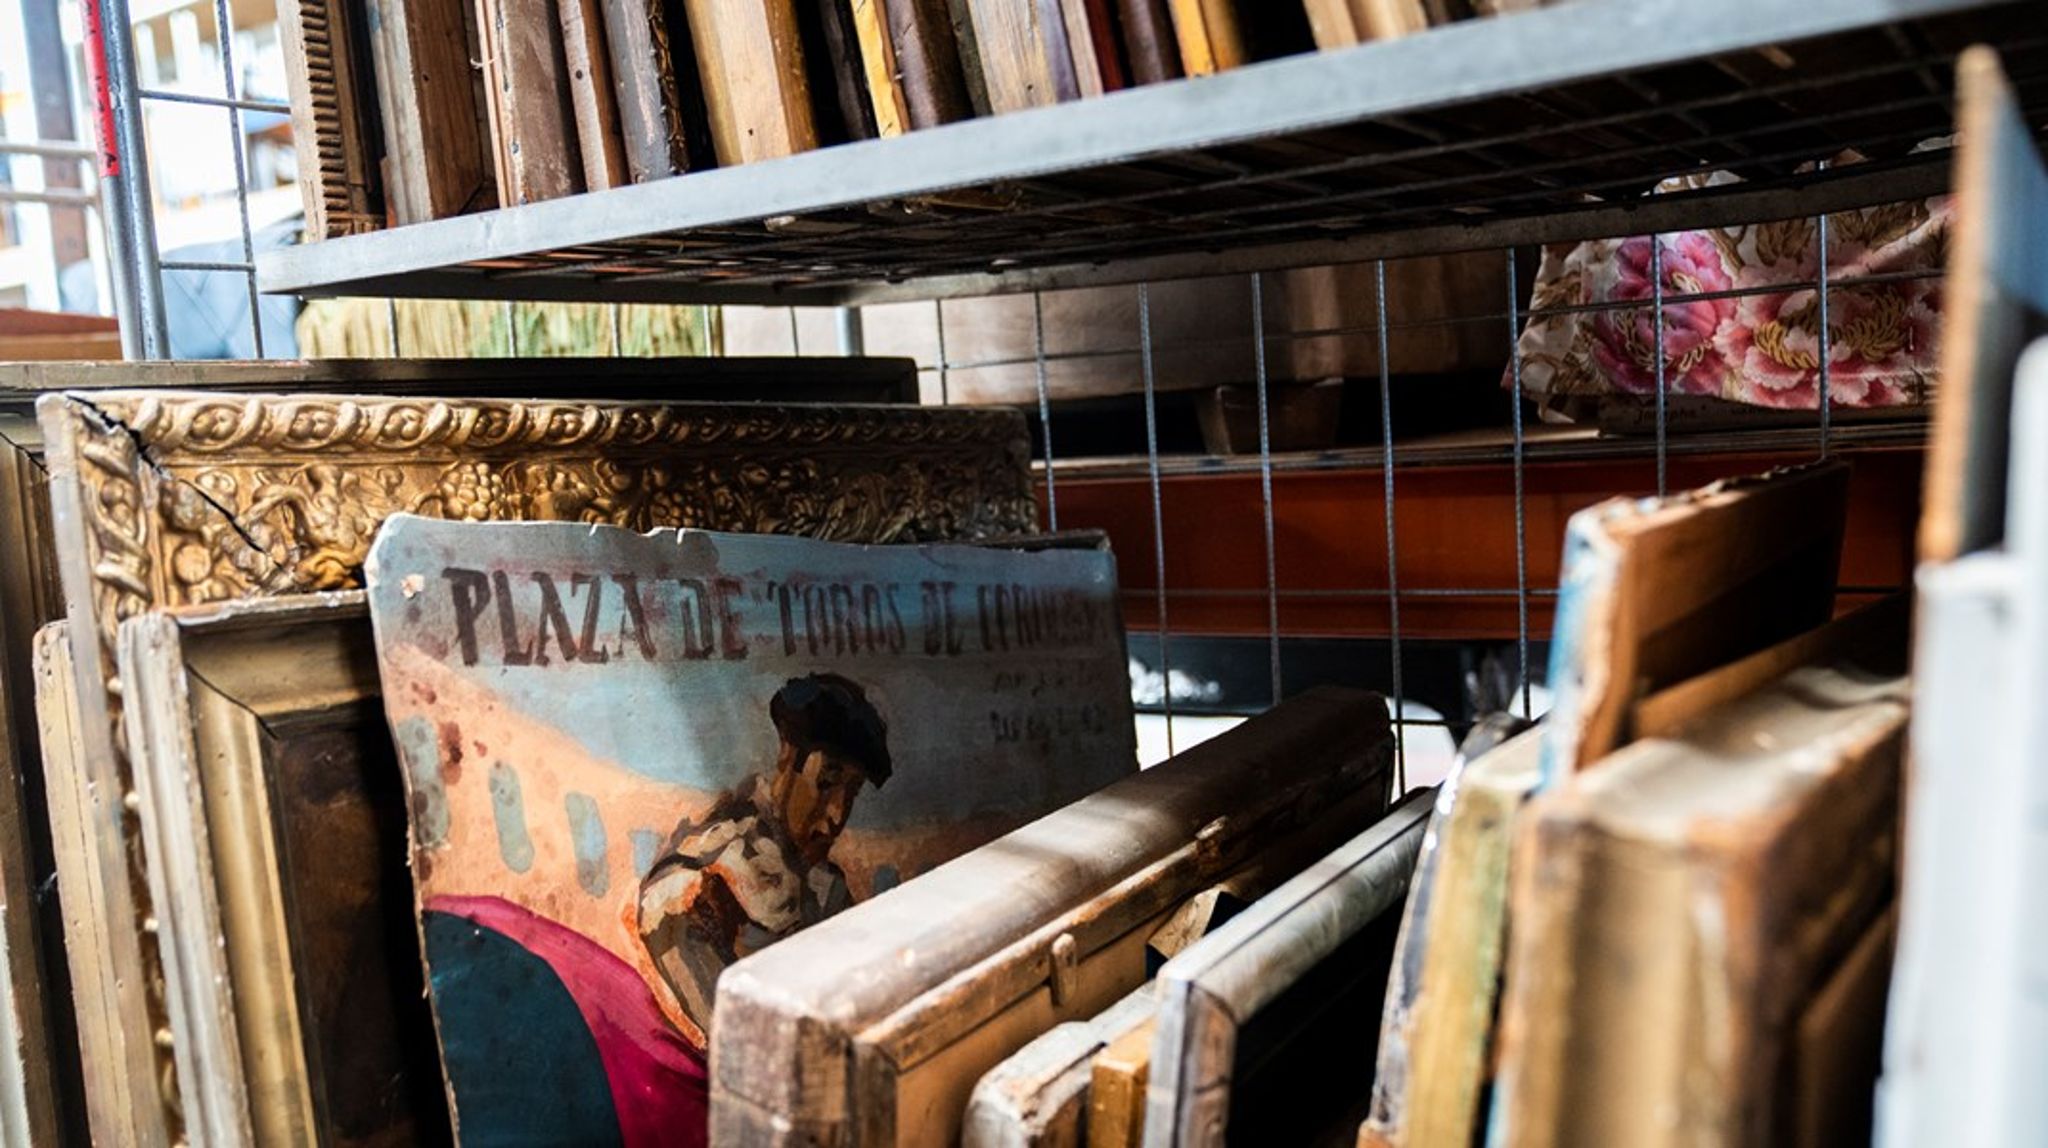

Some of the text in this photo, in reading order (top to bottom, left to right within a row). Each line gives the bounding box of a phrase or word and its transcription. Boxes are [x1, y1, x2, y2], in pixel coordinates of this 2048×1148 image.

[440, 566, 657, 667] PLAZA
[677, 577, 750, 662] DE
[766, 579, 907, 658] TOROS
[919, 579, 966, 657] DE
